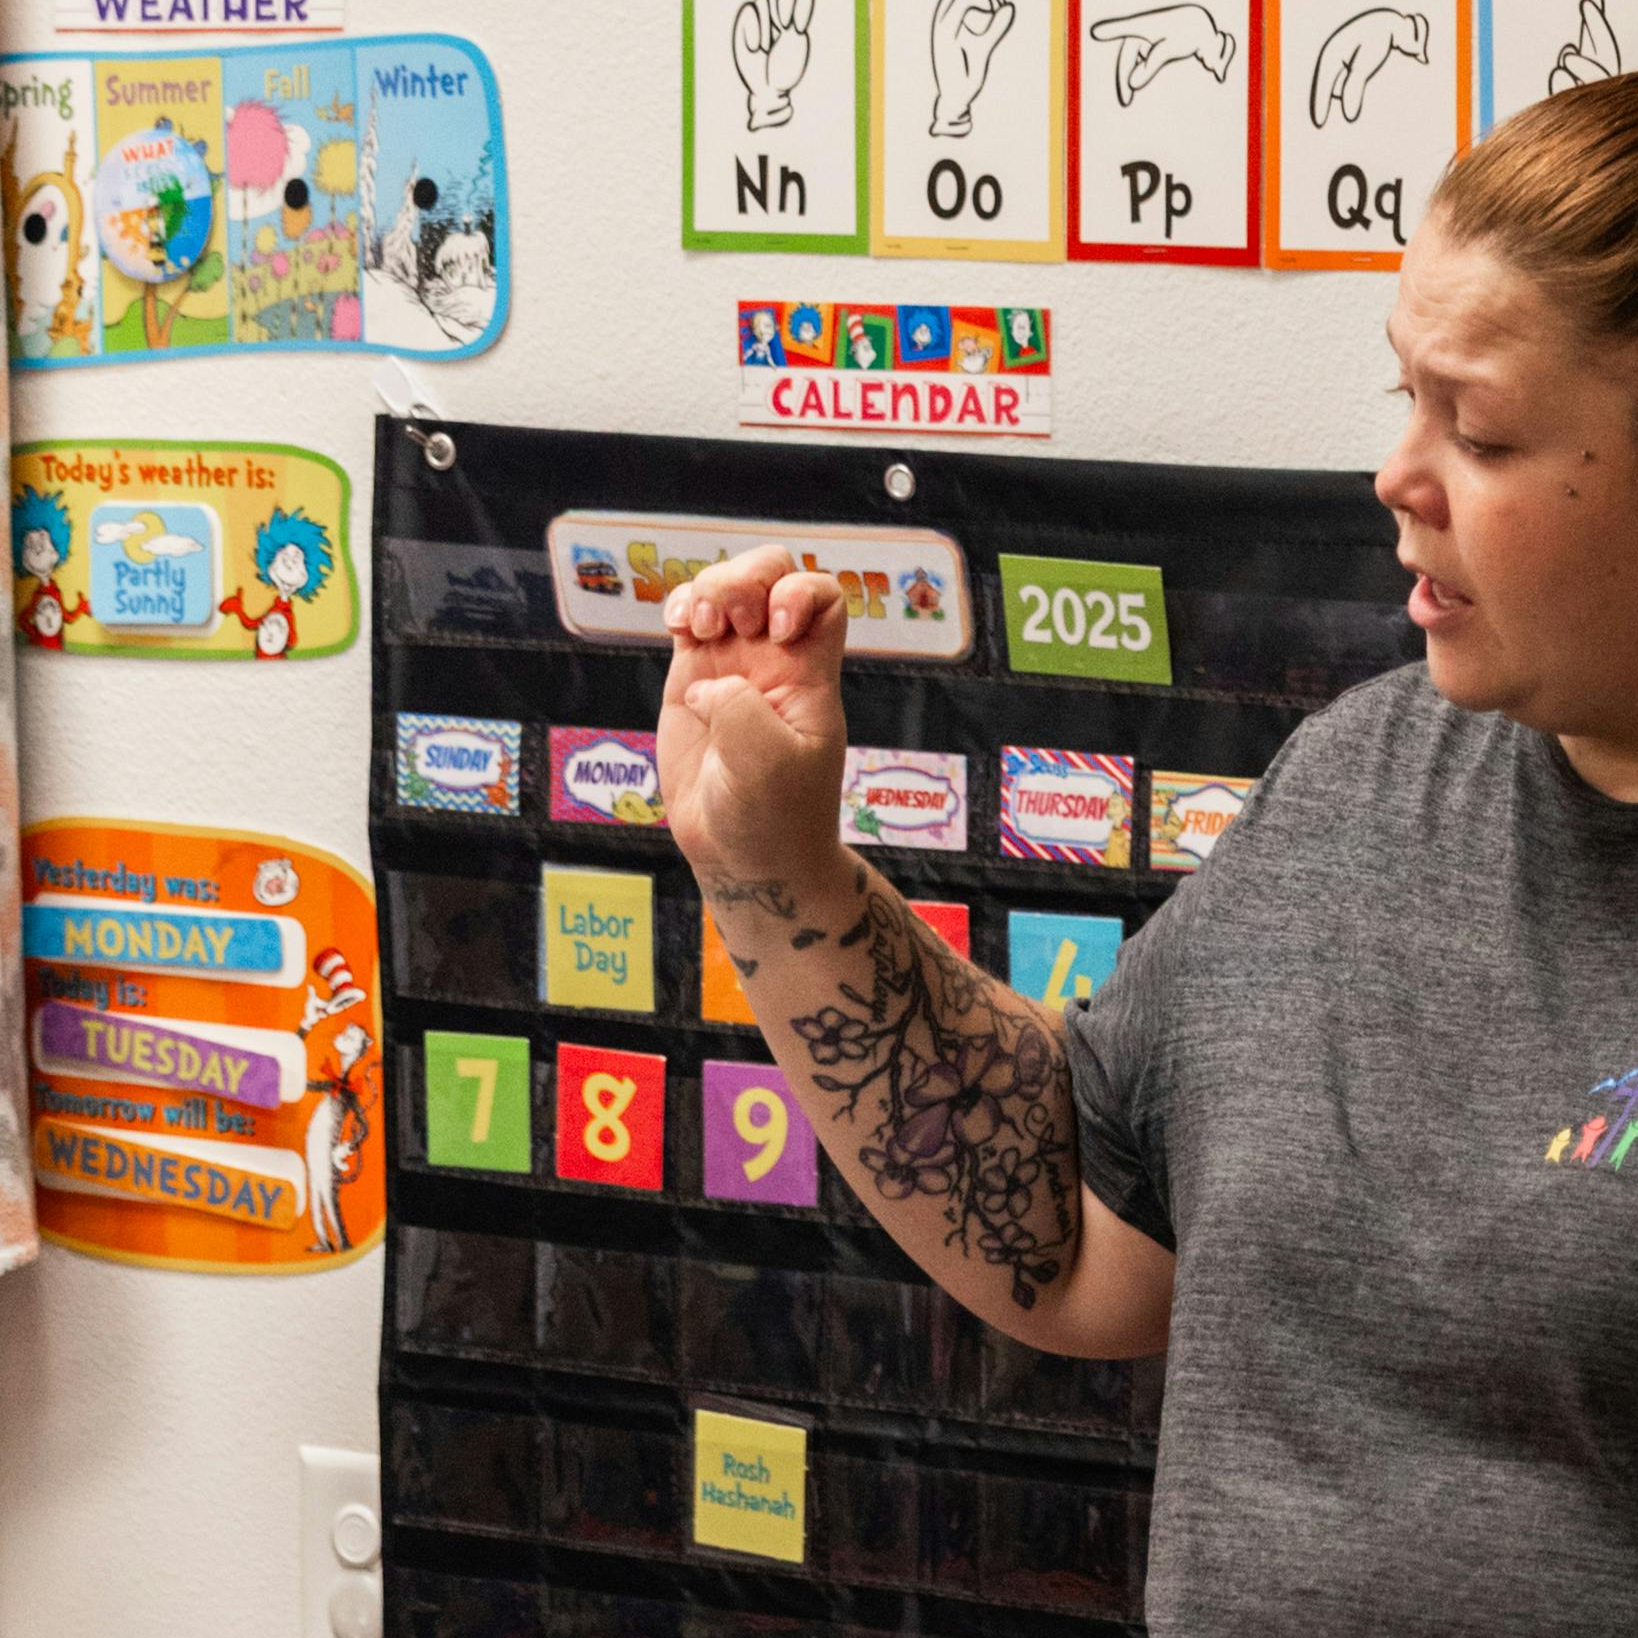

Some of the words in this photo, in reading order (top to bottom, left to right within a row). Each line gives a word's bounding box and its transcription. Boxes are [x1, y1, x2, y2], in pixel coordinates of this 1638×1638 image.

[0, 75, 75, 121] pring
[105, 73, 213, 106] Summer
[263, 65, 312, 101] Fall
[373, 64, 470, 100] Winter
[736, 155, 805, 215] Nn
[927, 159, 1002, 220] Oo
[1121, 161, 1192, 239] Pp
[1327, 162, 1408, 247] Qq
[770, 376, 1021, 427] CALENDAR
[42, 450, 131, 493] Today's
[138, 451, 240, 489] weather
[245, 459, 277, 490] is:
[113, 559, 187, 595] Partly
[114, 588, 187, 625] Sunny
[1018, 583, 1153, 653] 2025
[424, 743, 494, 774] SUNDAY
[573, 760, 651, 788] MONDAY
[865, 785, 949, 812] WEDNESDAY
[1016, 789, 1111, 822] THURSDAY
[32, 857, 156, 904] Yesterday
[164, 873, 220, 901] was:
[62, 916, 235, 966] MONDAY
[559, 901, 635, 940] Labor
[573, 939, 628, 986] Day
[1042, 938, 1093, 1012] 4
[38, 969, 112, 1010] Today
[117, 975, 148, 1008] is:
[81, 1019, 250, 1096] TUESDAY
[35, 1083, 156, 1124] Tomorrow
[163, 1098, 208, 1129] will
[214, 1105, 257, 1138] be:
[454, 1058, 498, 1145] 7
[580, 1070, 638, 1163] 8
[731, 1086, 789, 1185] 9
[47, 1130, 283, 1221] WEDNESDAY
[722, 1451, 771, 1484] Rosh
[701, 1479, 796, 1521] Hashanah
